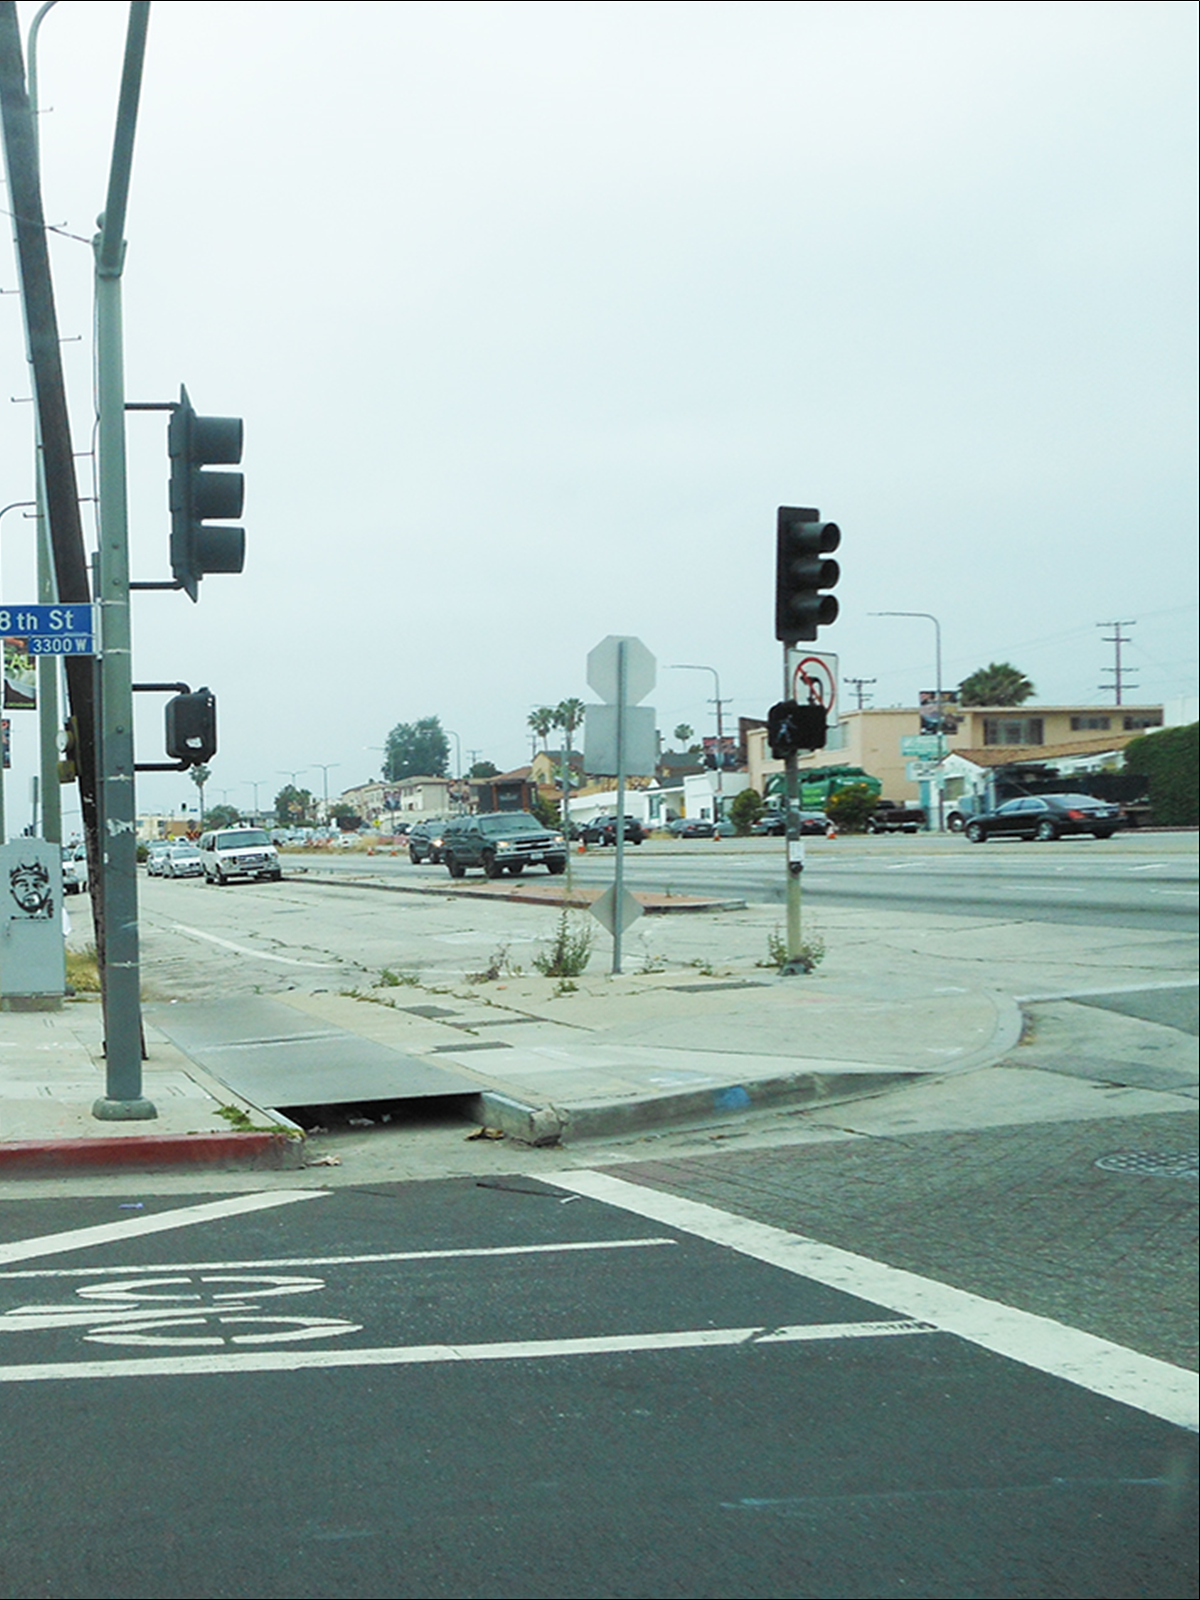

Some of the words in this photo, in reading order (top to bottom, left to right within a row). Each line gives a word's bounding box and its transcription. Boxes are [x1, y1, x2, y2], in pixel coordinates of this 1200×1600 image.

[49, 610, 74, 630] St
[33, 638, 72, 653] 3300
[75, 638, 88, 652] W
